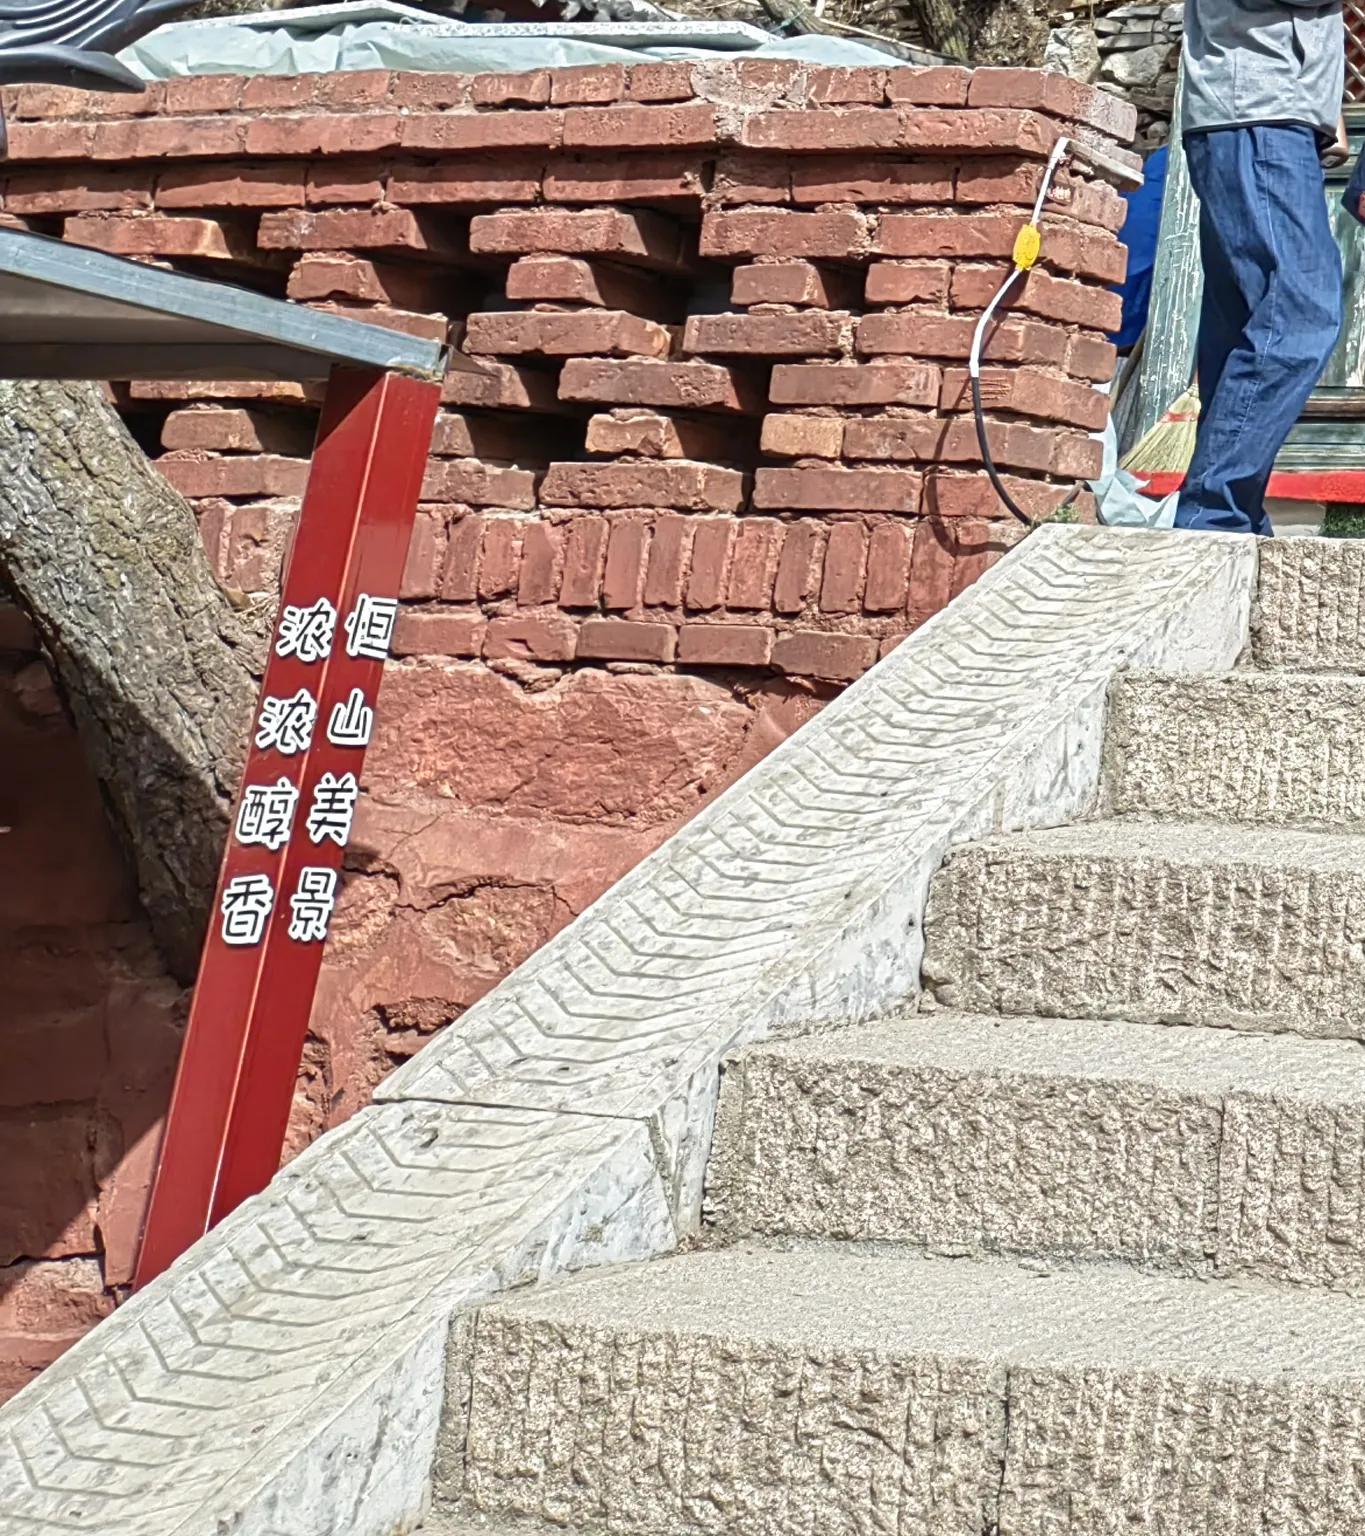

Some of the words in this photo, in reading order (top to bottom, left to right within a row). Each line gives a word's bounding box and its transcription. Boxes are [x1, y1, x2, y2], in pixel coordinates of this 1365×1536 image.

[222, 597, 337, 944] 浓浓醇香
[288, 593, 398, 941] 恒山美景
